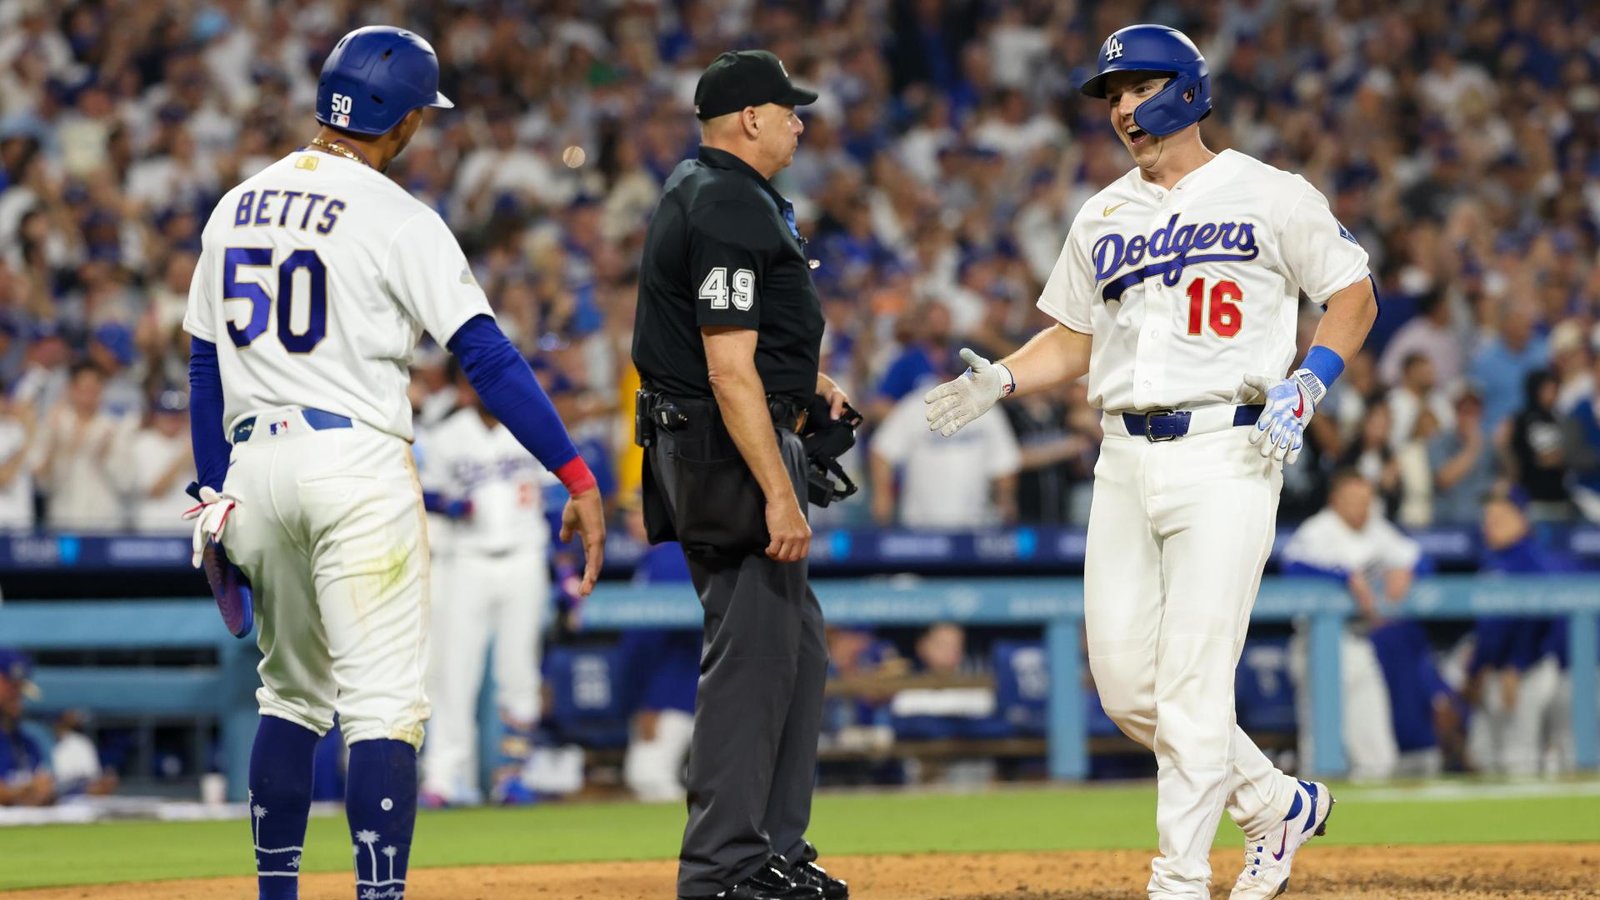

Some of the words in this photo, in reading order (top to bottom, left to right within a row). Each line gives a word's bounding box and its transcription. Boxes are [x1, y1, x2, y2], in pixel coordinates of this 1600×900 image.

[1105, 34, 1123, 61] LA
[331, 92, 353, 115] 50
[233, 189, 348, 236] BETTS
[1092, 213, 1260, 294] Dodgers
[222, 247, 329, 355] 50
[698, 266, 756, 312] 49
[1186, 276, 1245, 339] 16
